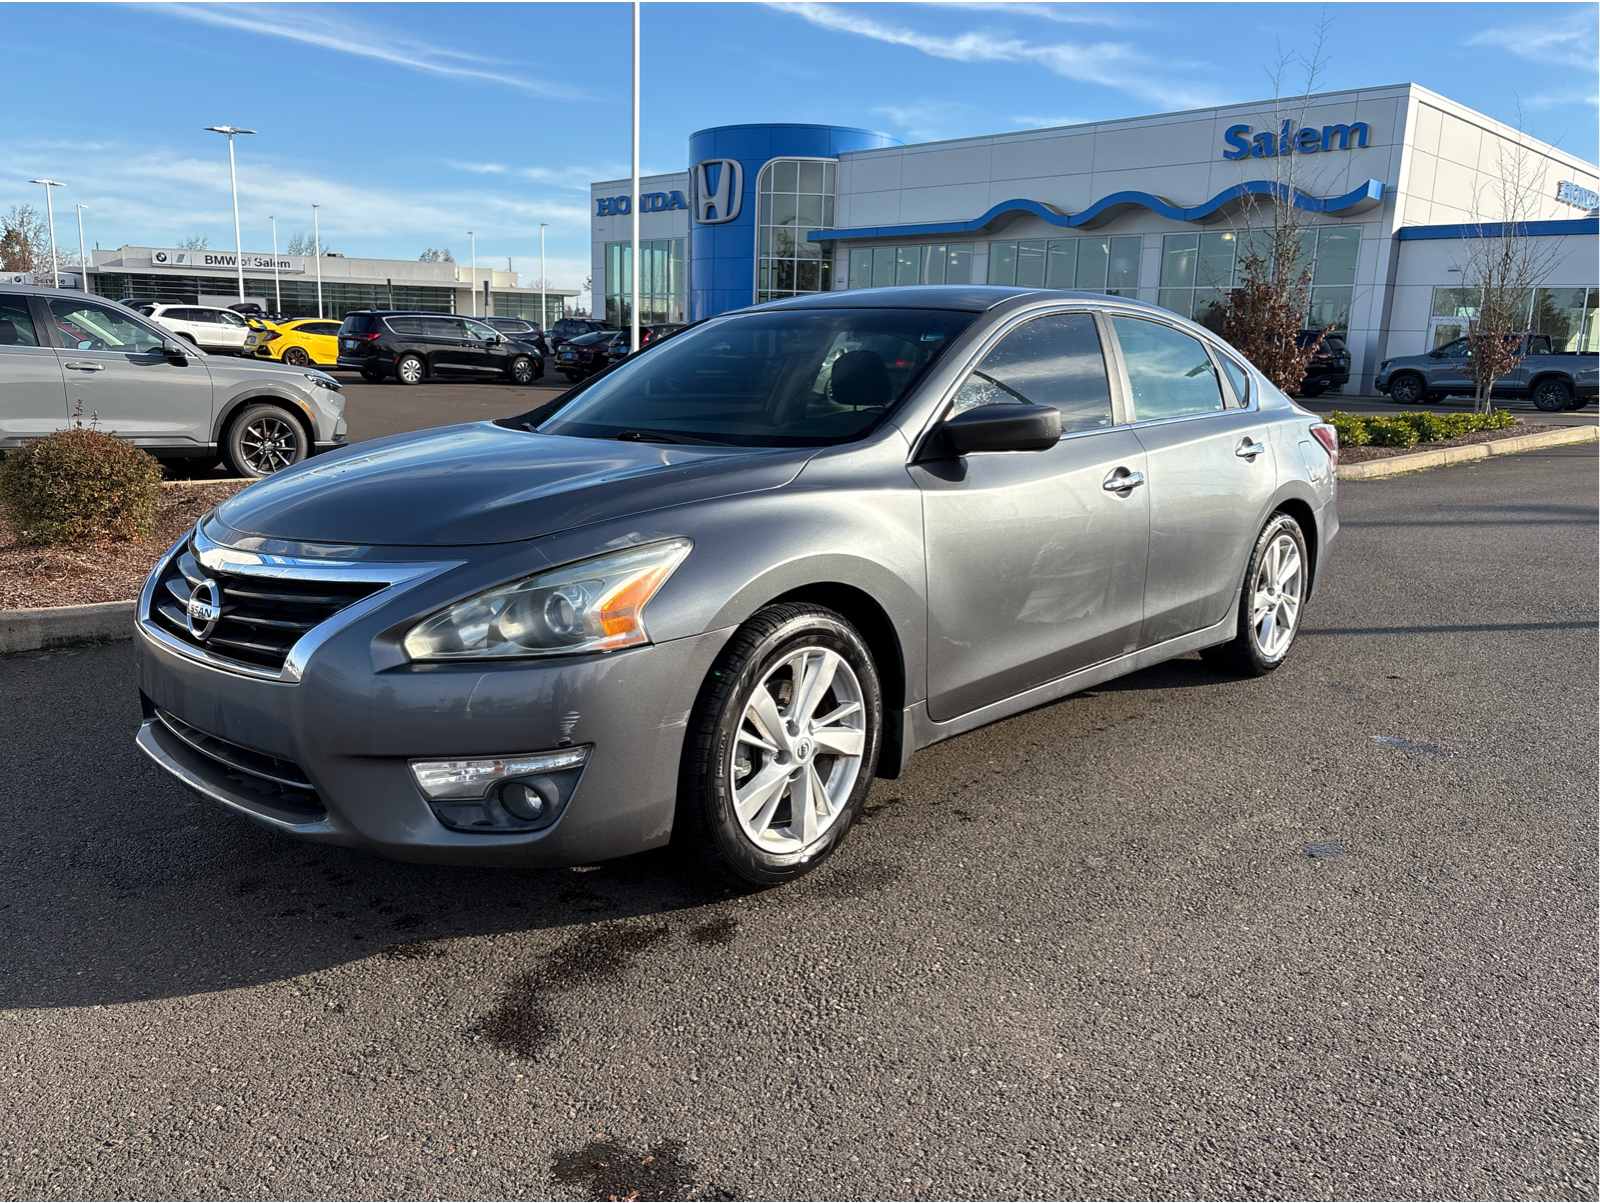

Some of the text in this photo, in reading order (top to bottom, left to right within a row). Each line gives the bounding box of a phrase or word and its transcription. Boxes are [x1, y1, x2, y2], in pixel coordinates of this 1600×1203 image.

[1223, 118, 1370, 160] Salem
[596, 190, 688, 216] HONDA
[204, 254, 237, 266] BMW
[254, 257, 291, 269] Salem
[33, 275, 66, 286] Servce
